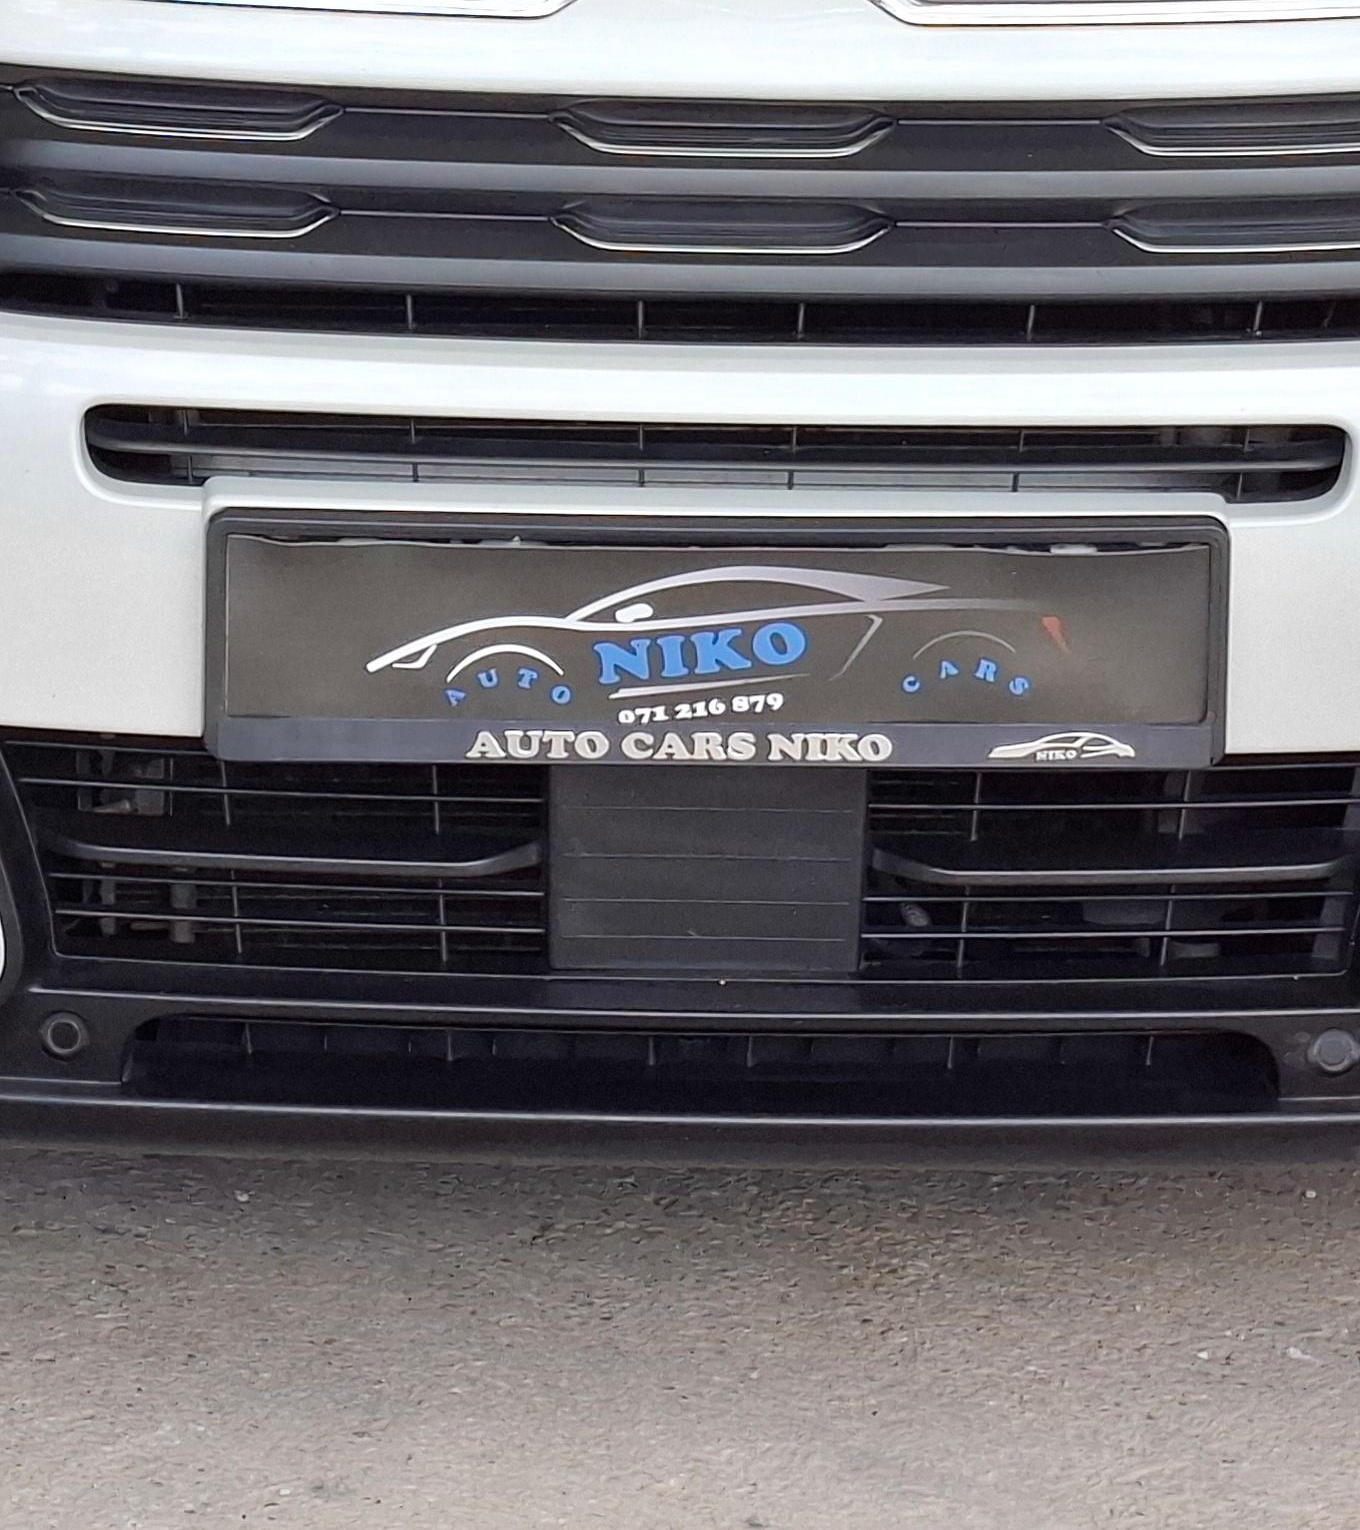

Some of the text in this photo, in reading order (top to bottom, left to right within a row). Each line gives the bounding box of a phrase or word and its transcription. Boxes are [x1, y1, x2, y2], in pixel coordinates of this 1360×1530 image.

[593, 621, 807, 685] NIKO
[445, 668, 571, 706] AUTO
[902, 657, 1030, 696] CARS
[617, 692, 784, 724] 071 216 879
[465, 730, 893, 762] AUTO CARS NIKO
[1035, 748, 1078, 762] NIKO
